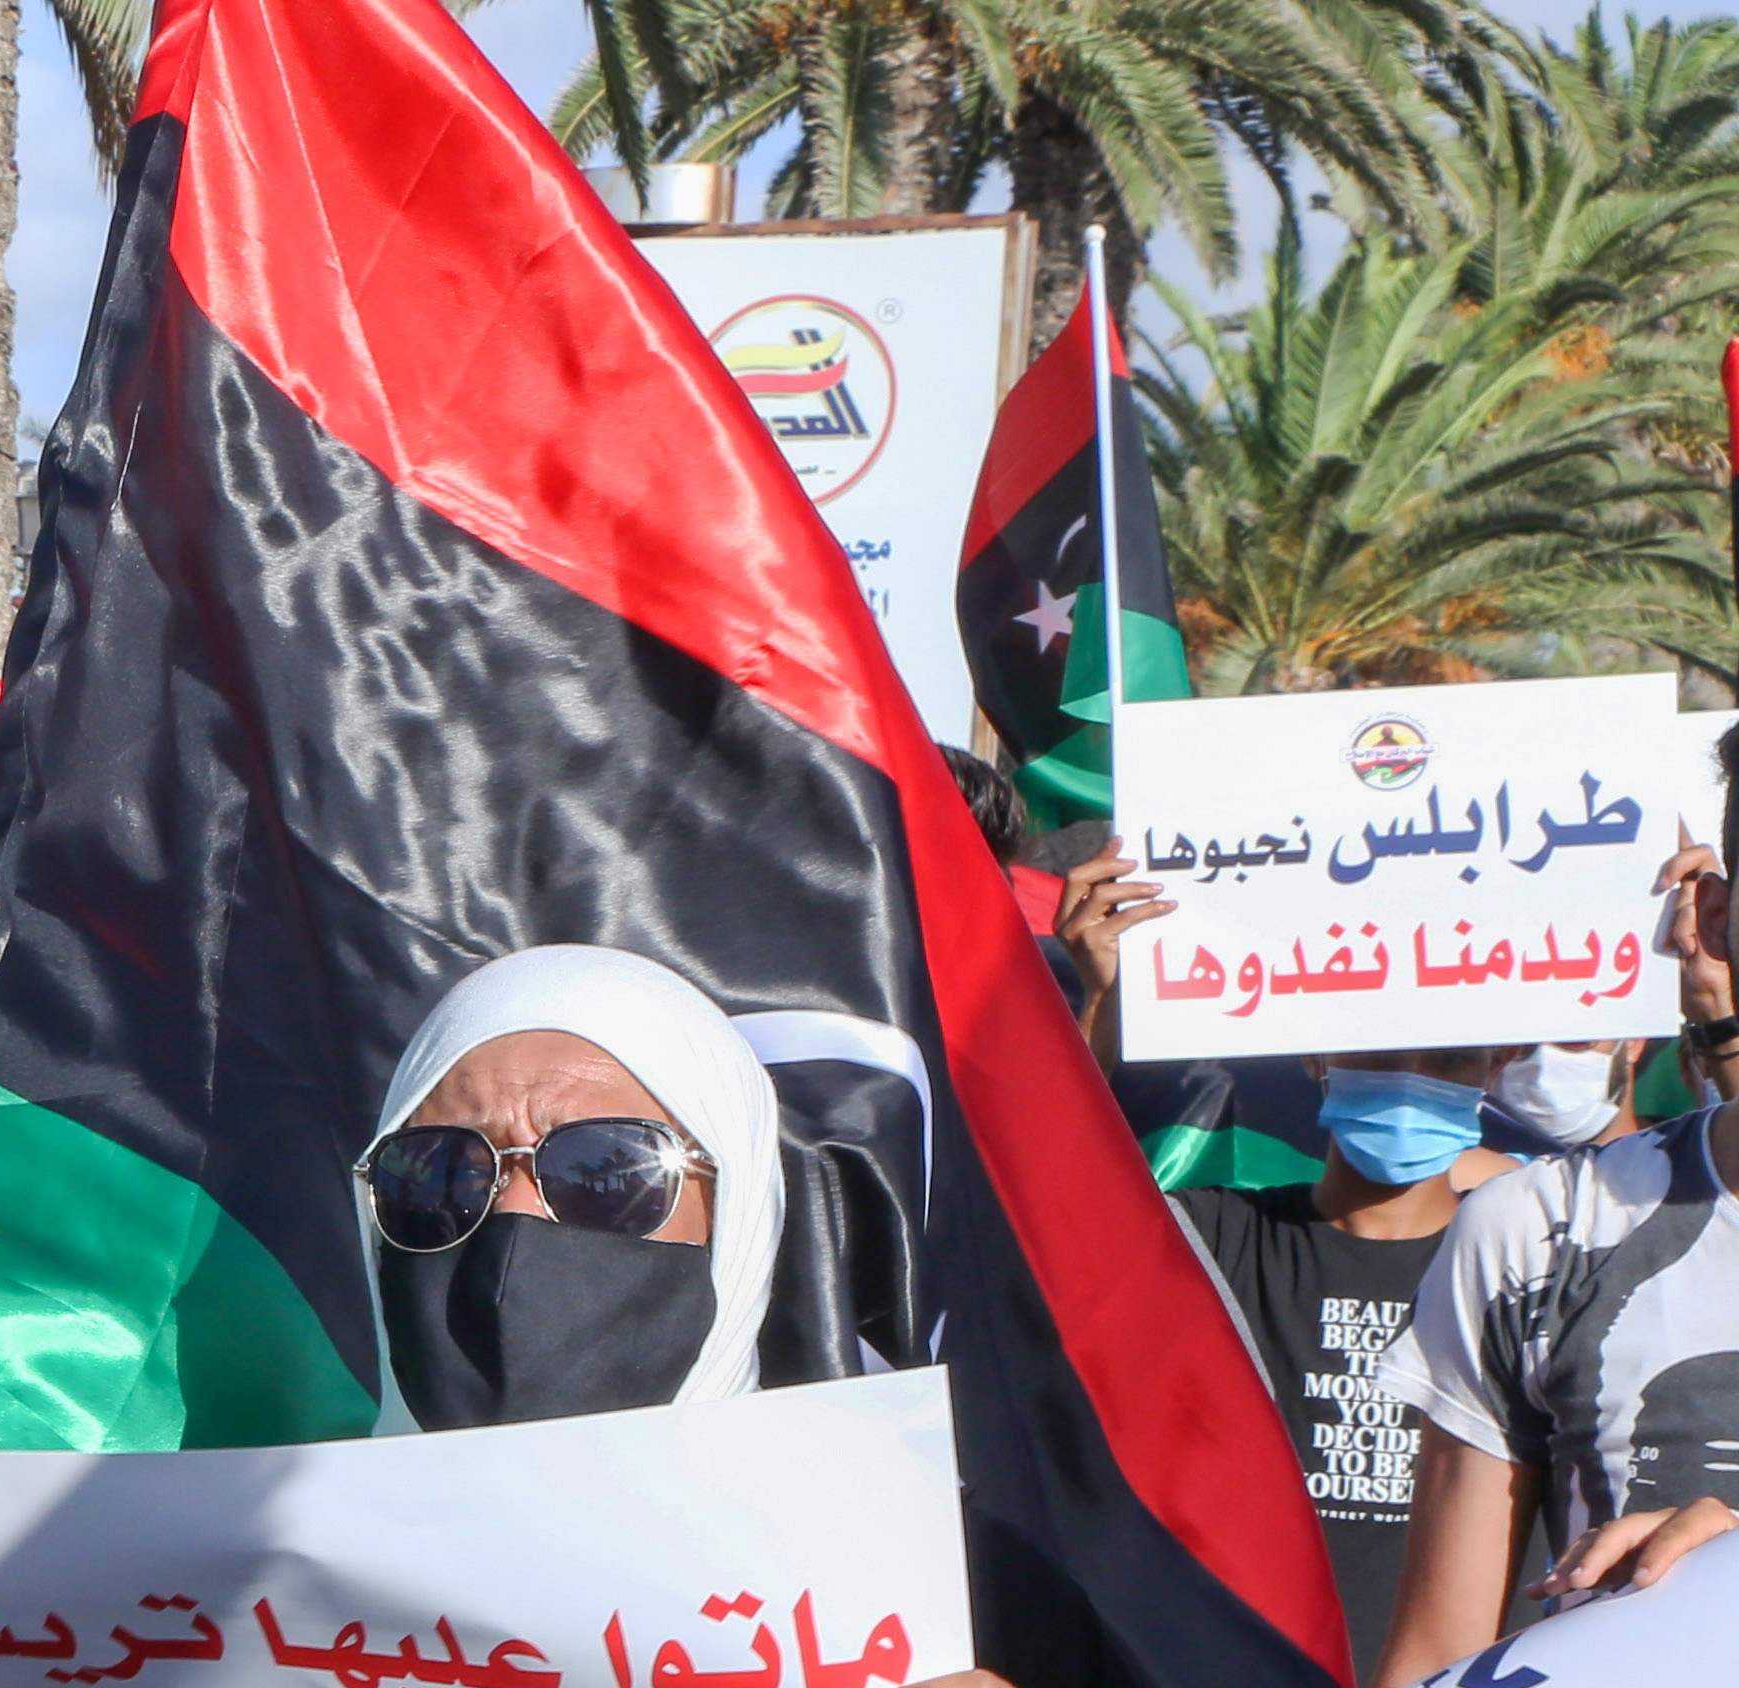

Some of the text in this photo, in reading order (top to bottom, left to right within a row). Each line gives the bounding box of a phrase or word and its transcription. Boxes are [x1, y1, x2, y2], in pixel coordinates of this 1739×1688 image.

[1144, 769, 1644, 886] طرابلس نحبوها
[1152, 918, 1642, 1018] وبدمنا نفدوها
[1320, 1297, 1411, 1328] BEAU
[1321, 1324, 1396, 1352] BEG
[1338, 1400, 1405, 1428] YOU
[1323, 1449, 1413, 1480] TO BE
[1304, 1472, 1416, 1504] OURSE
